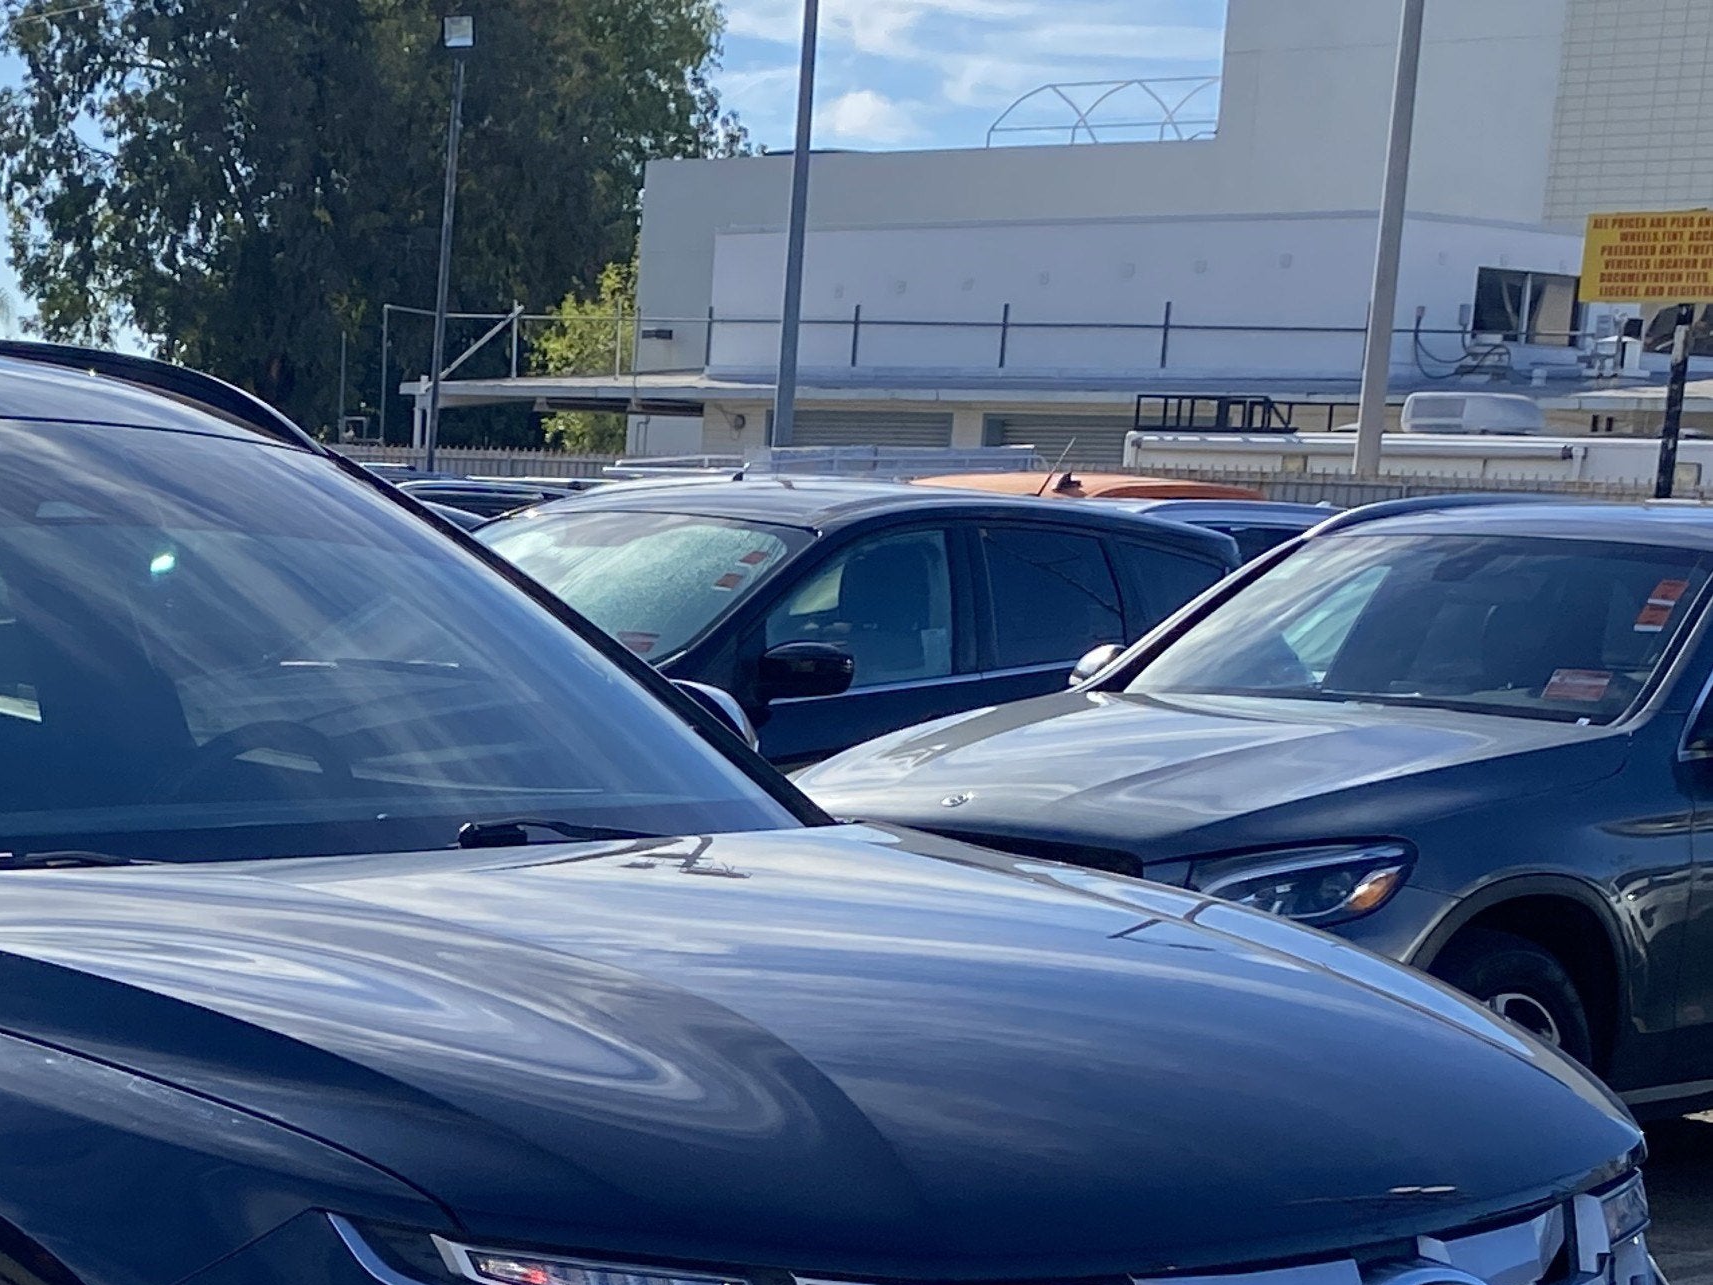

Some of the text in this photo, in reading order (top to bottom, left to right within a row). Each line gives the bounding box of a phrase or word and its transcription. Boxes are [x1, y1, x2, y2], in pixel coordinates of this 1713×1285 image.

[1593, 218, 1608, 229] ALL
[1612, 217, 1646, 229] PRICES
[1650, 217, 1667, 228] ARE
[1671, 217, 1695, 228] PLUS
[1601, 245, 1657, 257] PRELOADED
[1605, 258, 1650, 270] VEHICLES
[1653, 257, 1698, 269] LOCATOR
[1600, 272, 1683, 283] DOCUMENTATION
[1645, 285, 1665, 297] AND
